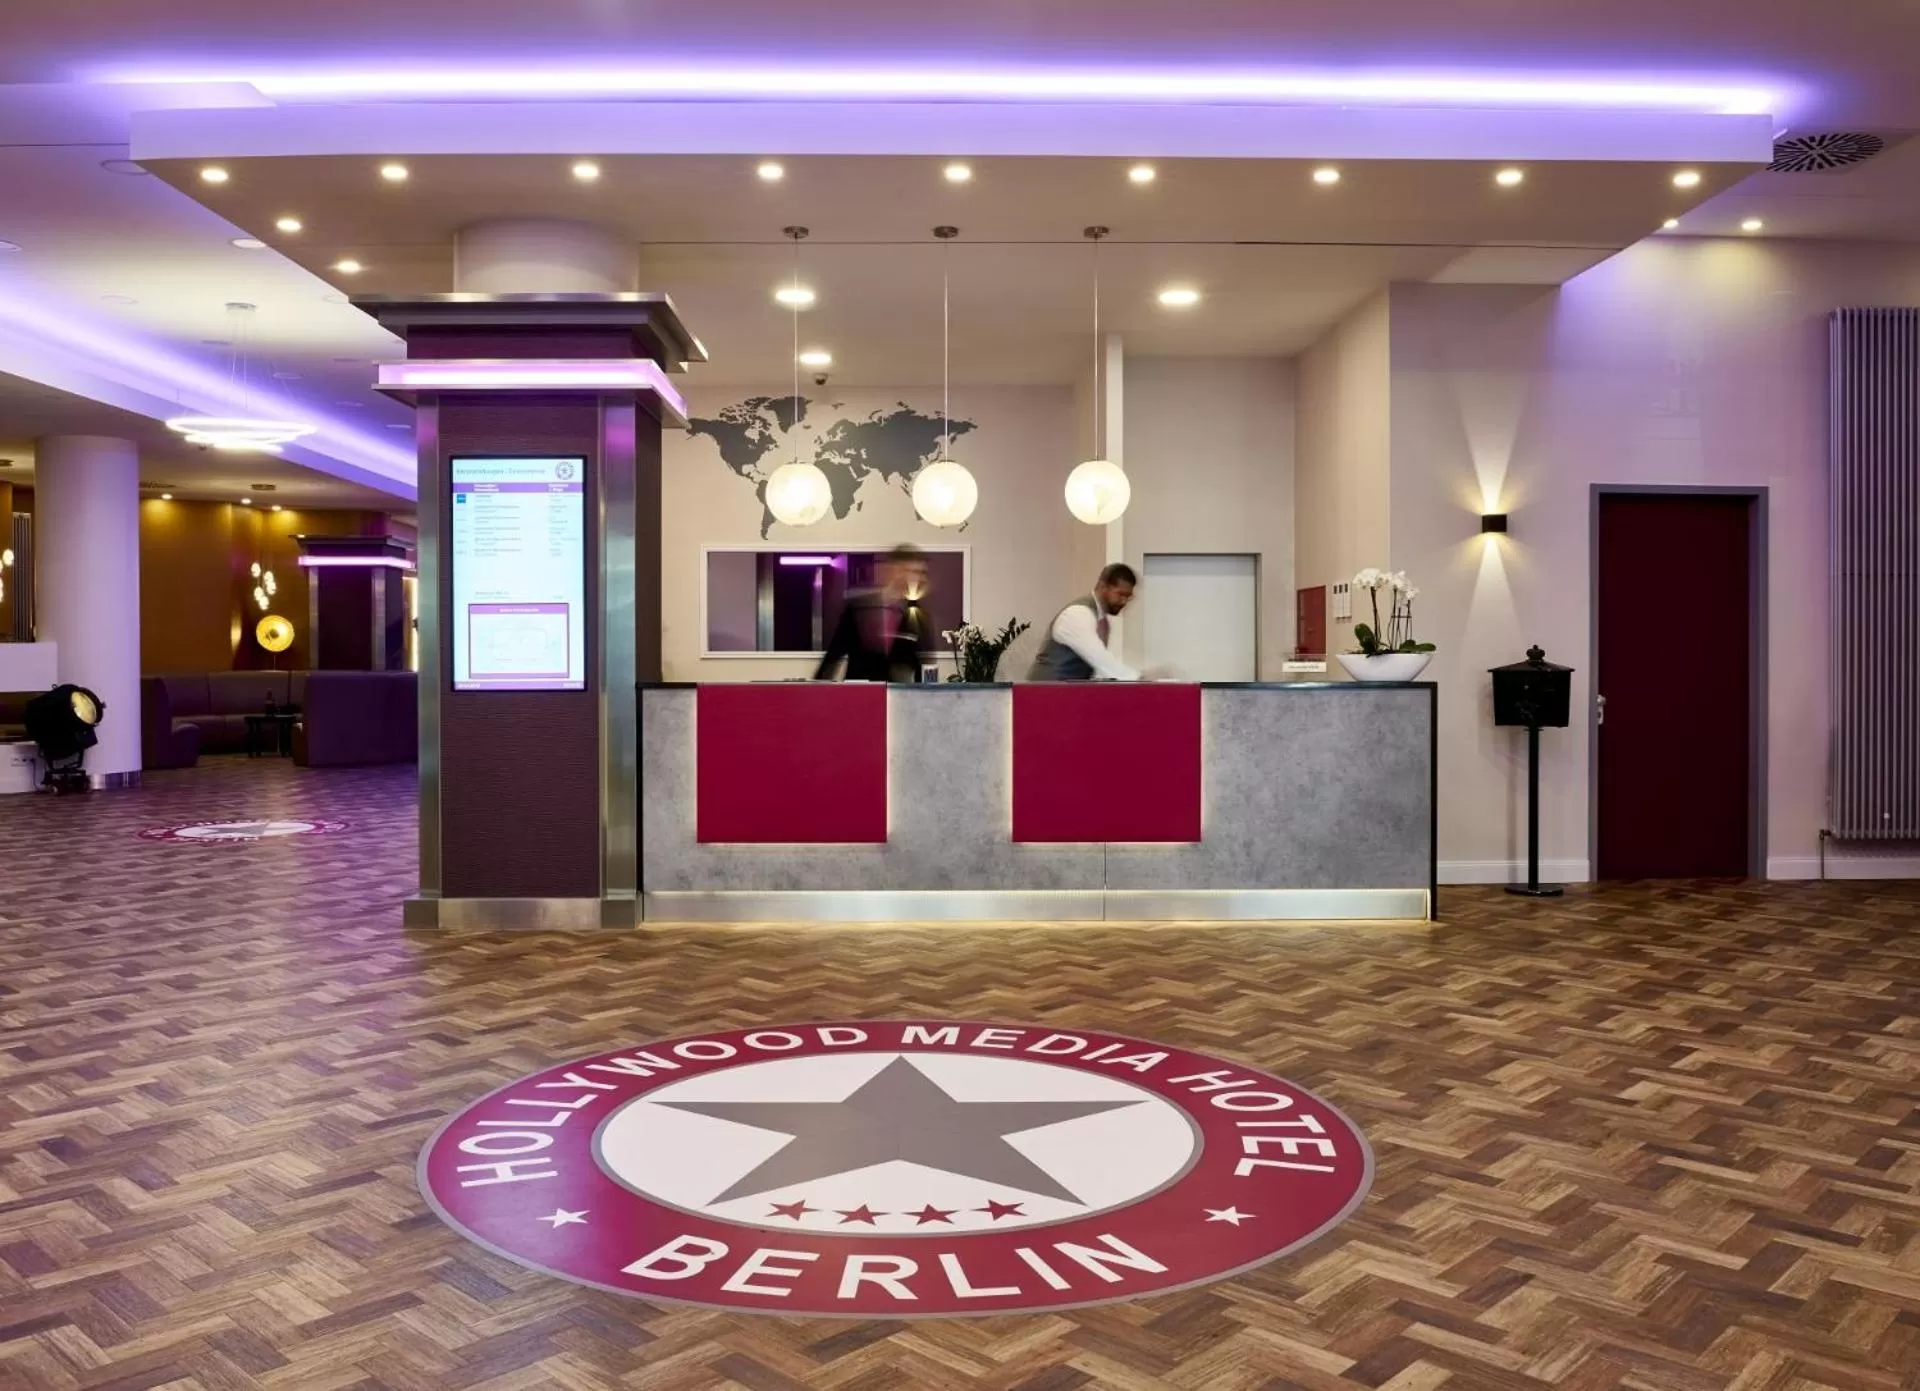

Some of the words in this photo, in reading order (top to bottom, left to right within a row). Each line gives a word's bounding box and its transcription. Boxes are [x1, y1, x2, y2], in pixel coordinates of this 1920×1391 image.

[456, 1027, 868, 1188] HOLLYWOOD
[901, 1026, 1170, 1072] MEDIA
[1167, 1070, 1336, 1177] HOTEL
[620, 1233, 1169, 1300] BERLIN
